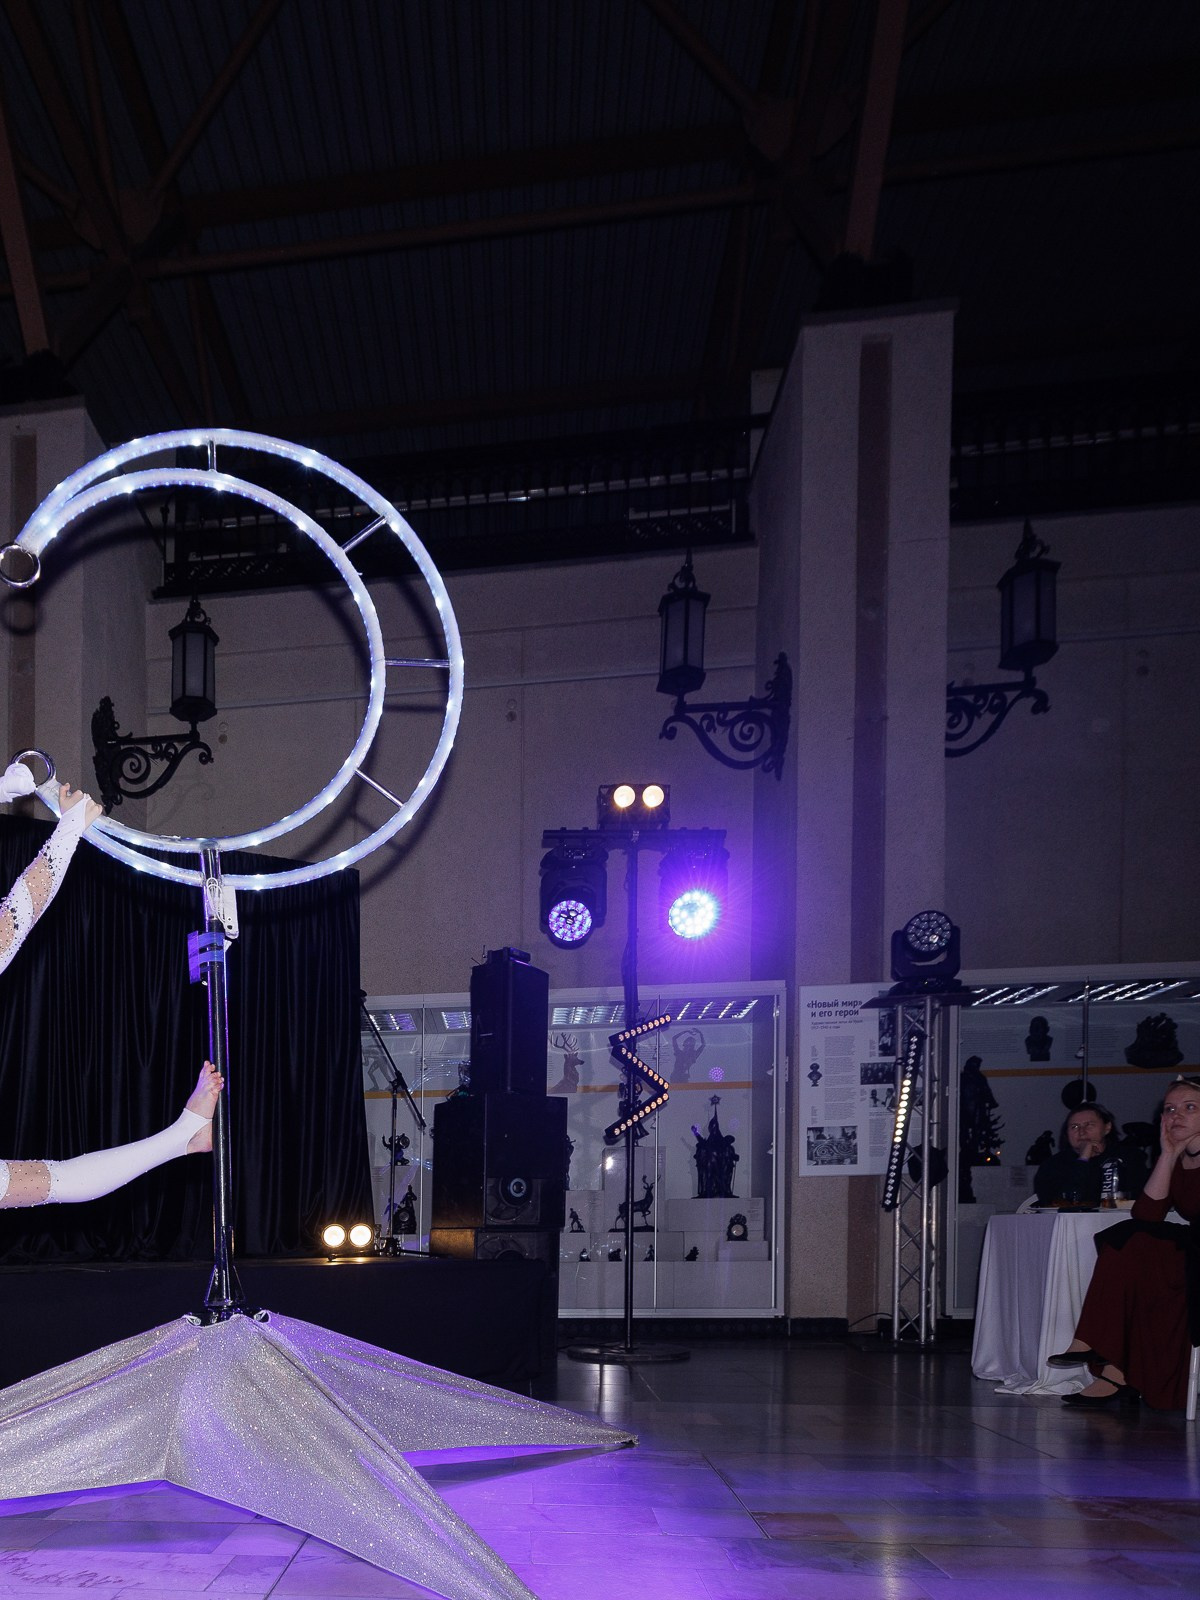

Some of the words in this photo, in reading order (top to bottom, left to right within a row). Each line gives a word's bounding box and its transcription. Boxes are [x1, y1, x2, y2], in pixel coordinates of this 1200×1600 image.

[806, 999, 839, 1008] «Новый
[841, 1000, 863, 1009] мир»
[818, 1010, 833, 1018] его
[835, 1009, 859, 1018] герои
[1102, 1168, 1113, 1192] Rich
